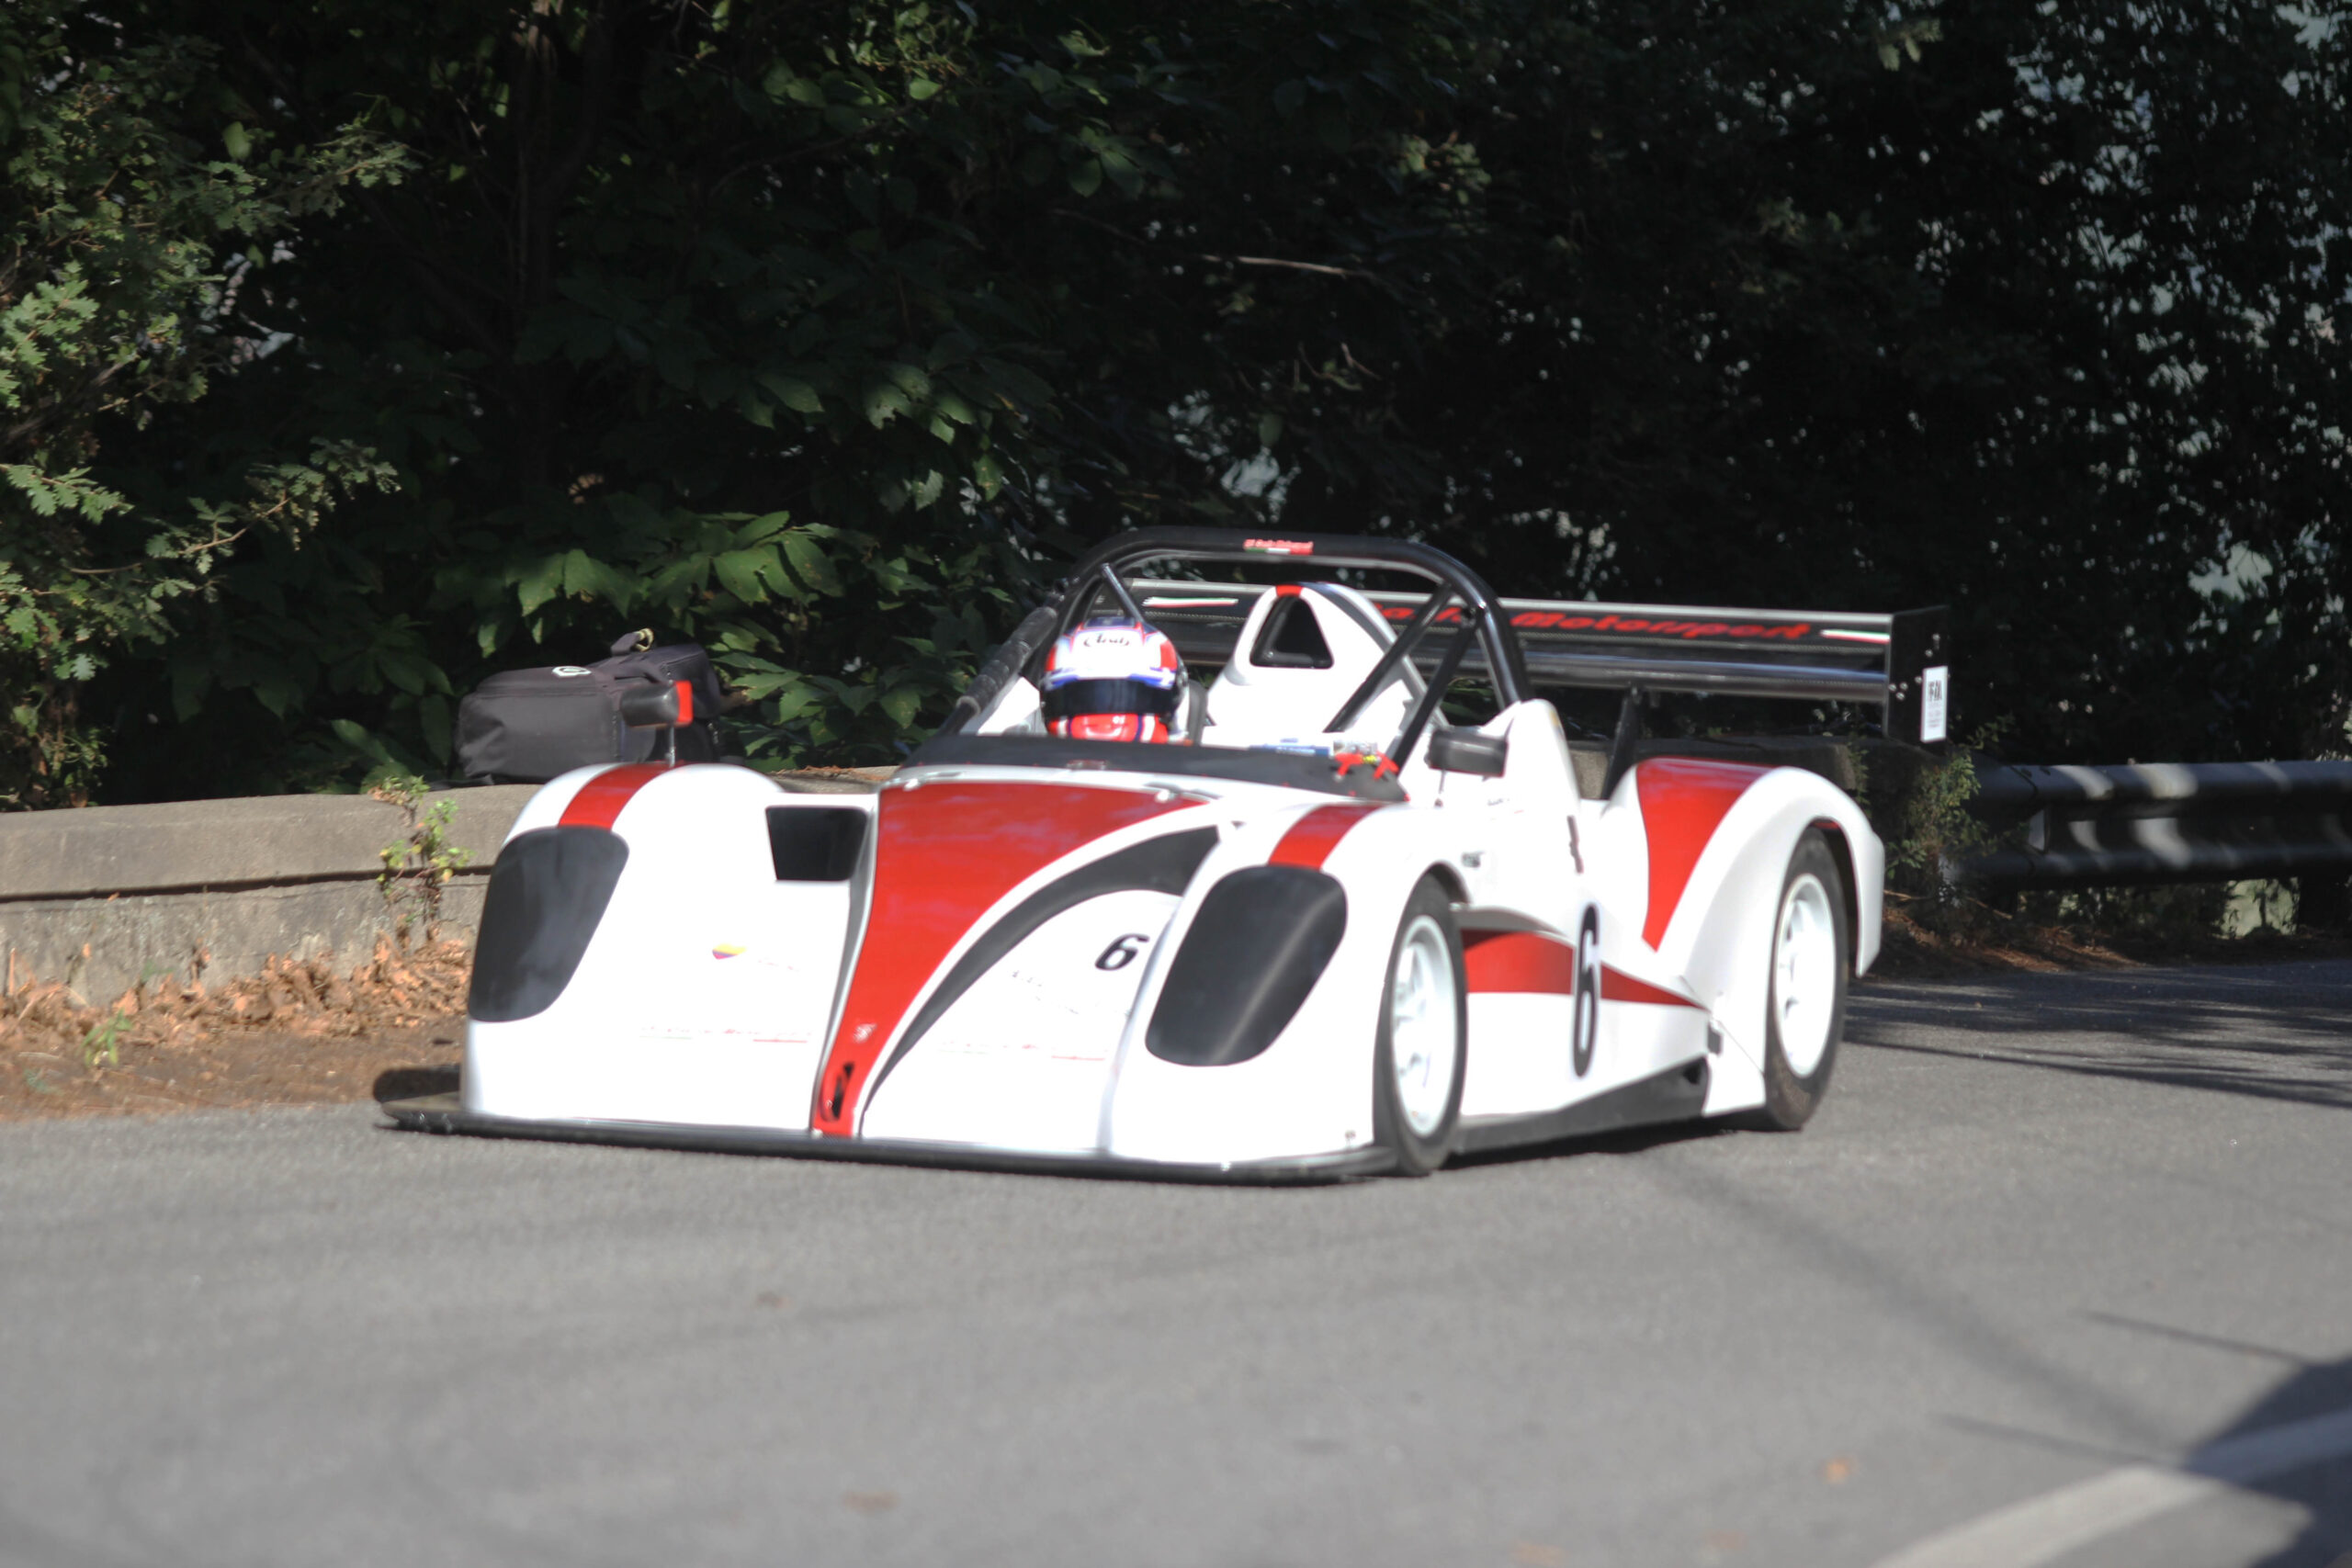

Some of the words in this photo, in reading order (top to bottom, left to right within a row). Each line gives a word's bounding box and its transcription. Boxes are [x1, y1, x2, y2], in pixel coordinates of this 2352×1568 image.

[1510, 612, 1811, 639] Motorsport
[1094, 932, 1150, 972] 6
[1573, 903, 1599, 1077] 6
